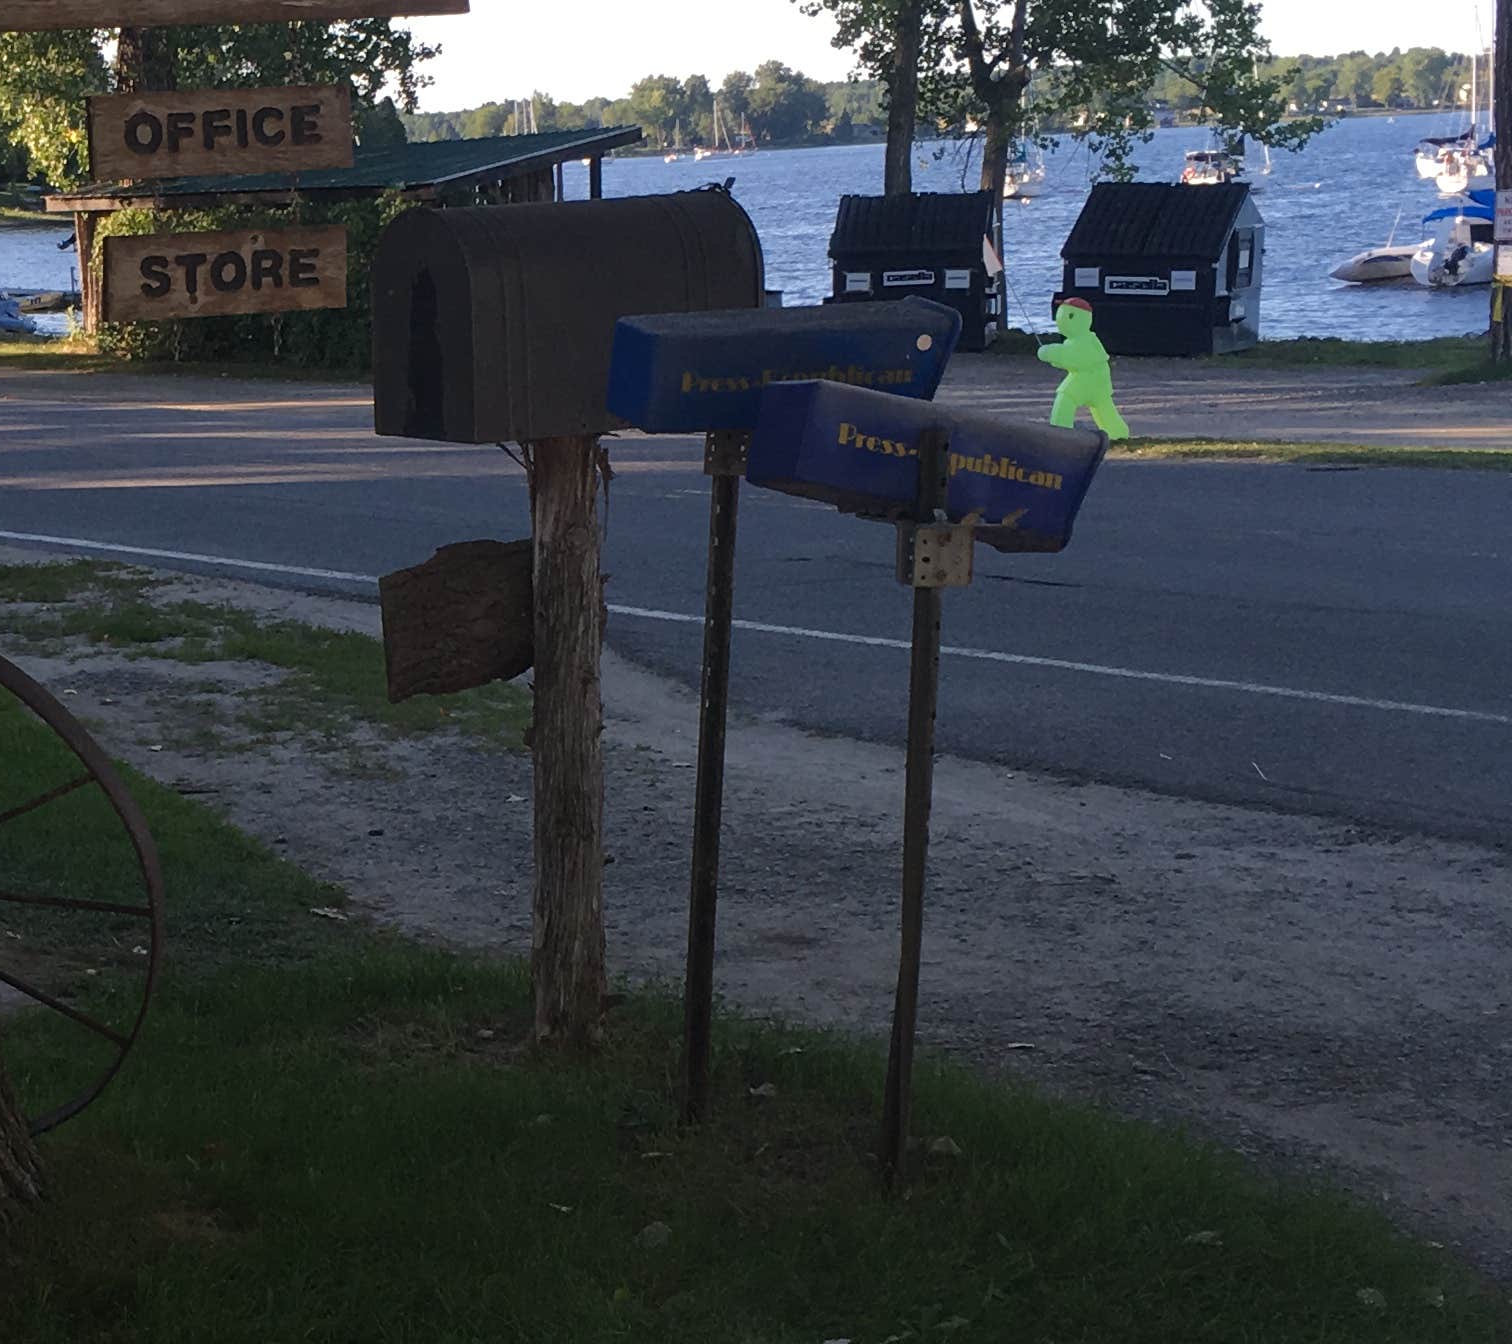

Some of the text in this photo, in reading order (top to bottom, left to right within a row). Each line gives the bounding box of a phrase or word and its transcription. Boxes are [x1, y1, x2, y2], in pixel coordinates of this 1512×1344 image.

[124, 103, 324, 155] OFFICE
[140, 248, 320, 298] STORE
[838, 422, 1063, 490] Press-publican
